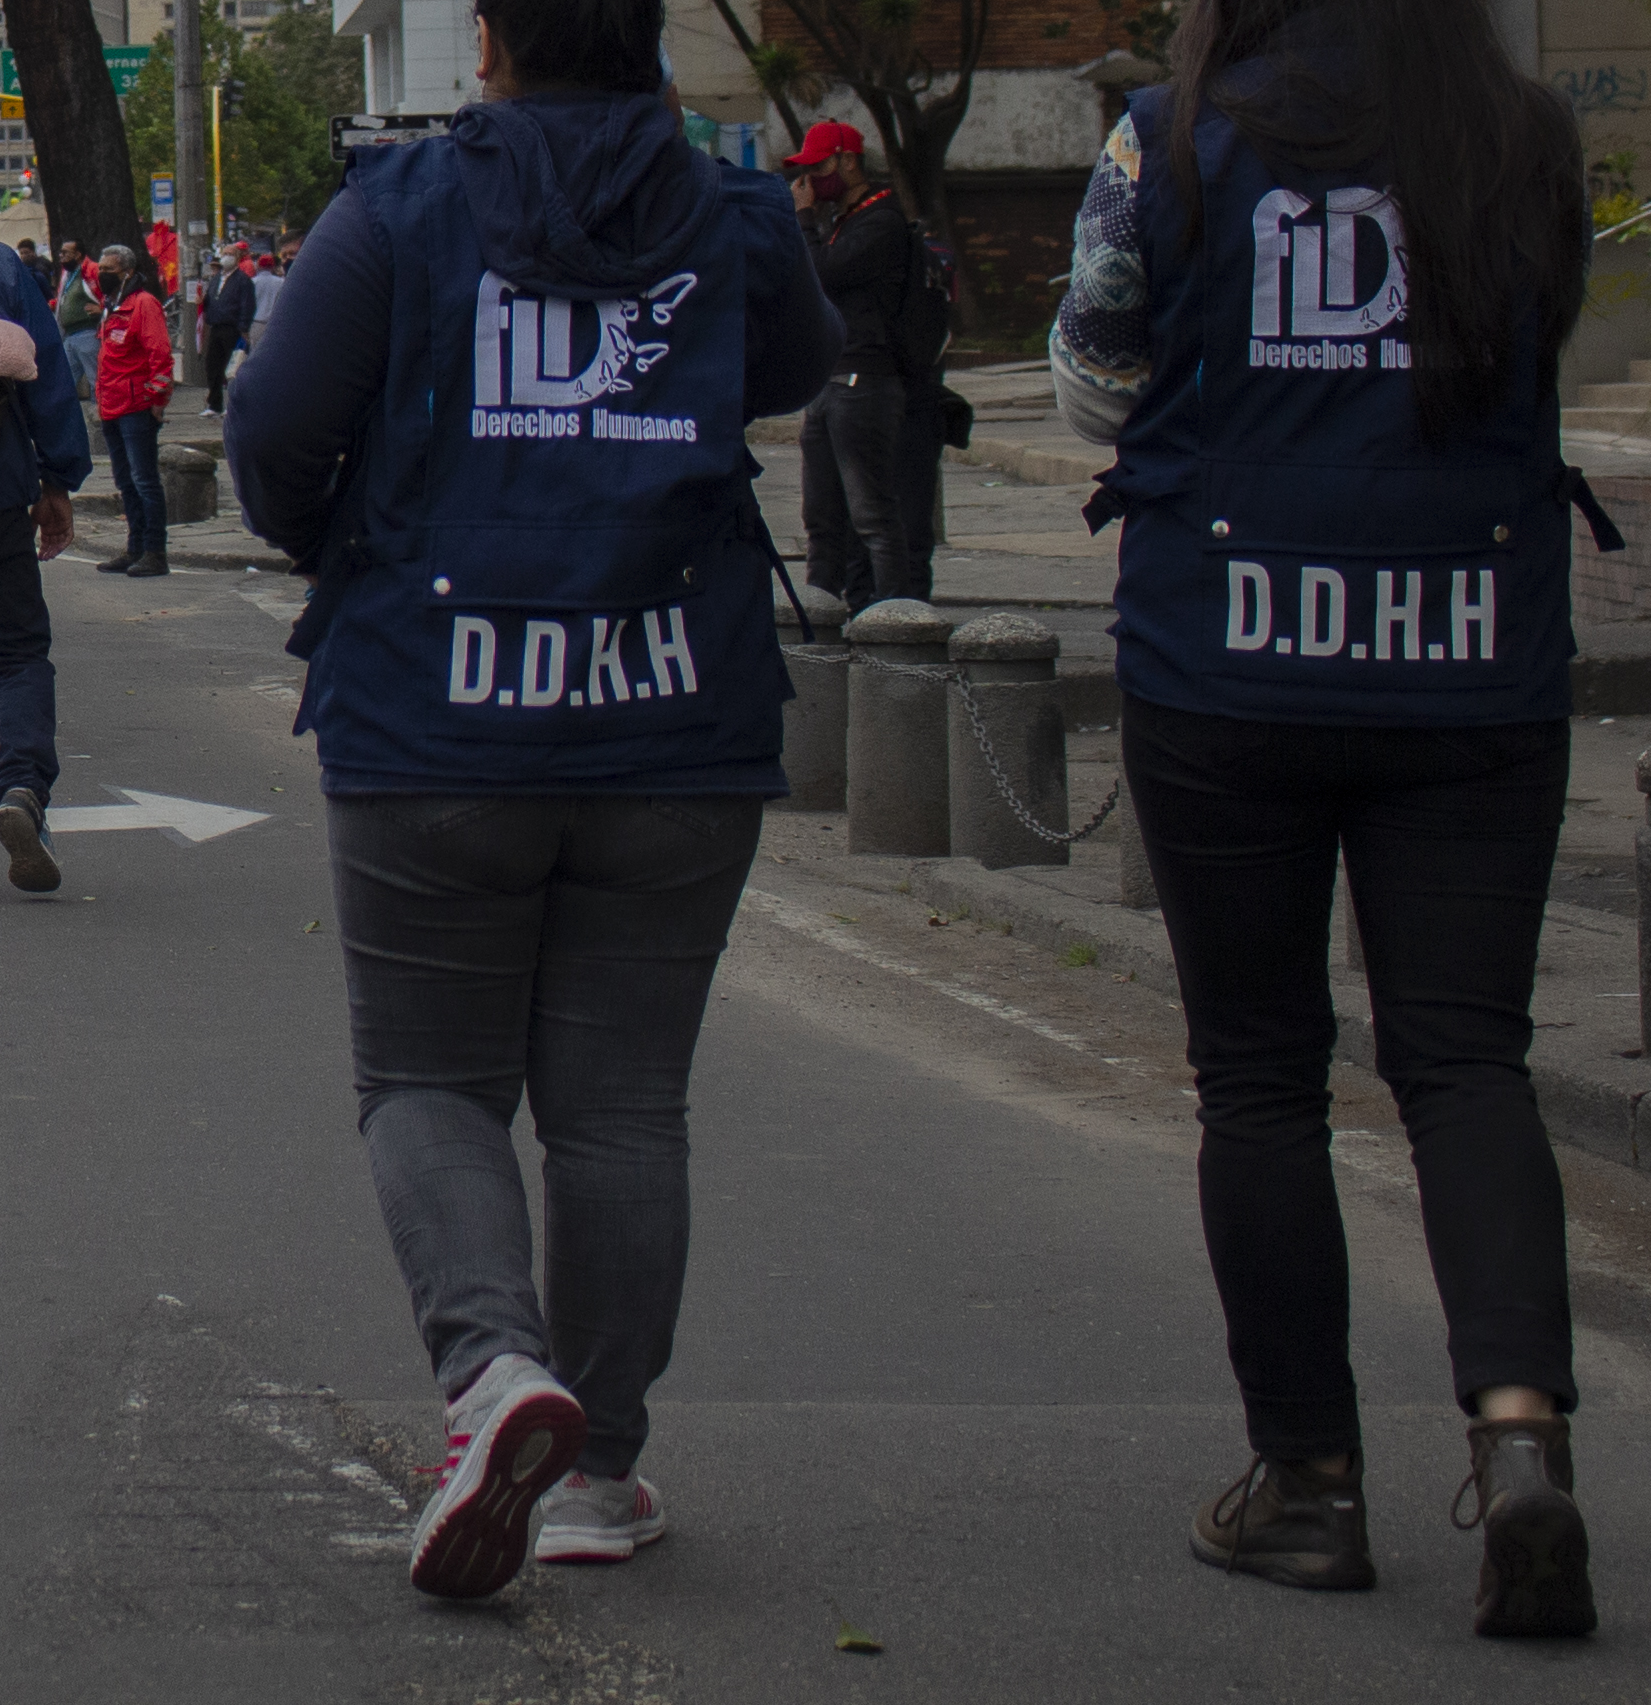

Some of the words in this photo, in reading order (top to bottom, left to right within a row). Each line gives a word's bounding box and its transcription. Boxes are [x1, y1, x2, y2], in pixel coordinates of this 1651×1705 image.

[1249, 339, 1368, 370] Derechos
[471, 408, 581, 438] Derechos
[591, 407, 698, 443] Humanos
[1225, 559, 1495, 661] D.D.H.H
